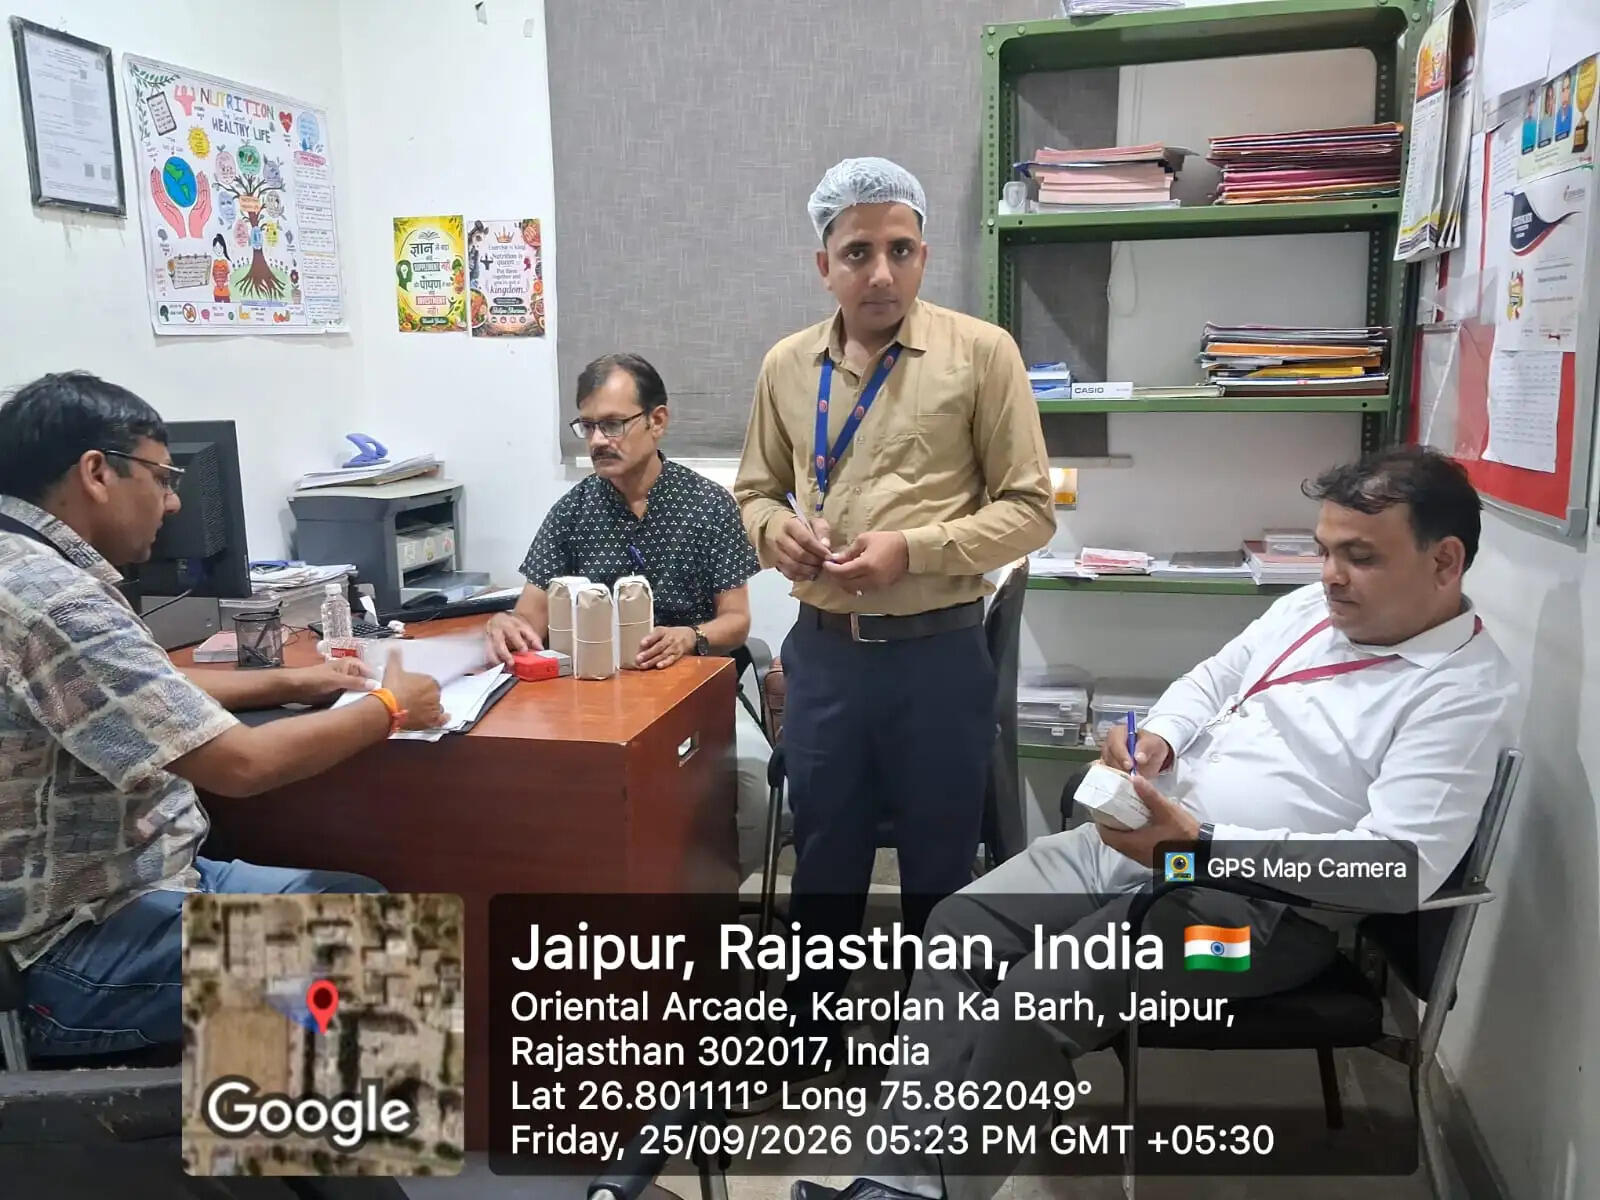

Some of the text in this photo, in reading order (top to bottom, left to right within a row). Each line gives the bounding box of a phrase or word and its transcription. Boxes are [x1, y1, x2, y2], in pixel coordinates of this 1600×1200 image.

[200, 87, 275, 120] NUTRITION
[211, 116, 250, 137] HEALTHY
[253, 128, 271, 144] LIFE
[408, 242, 434, 257] ज्ञान
